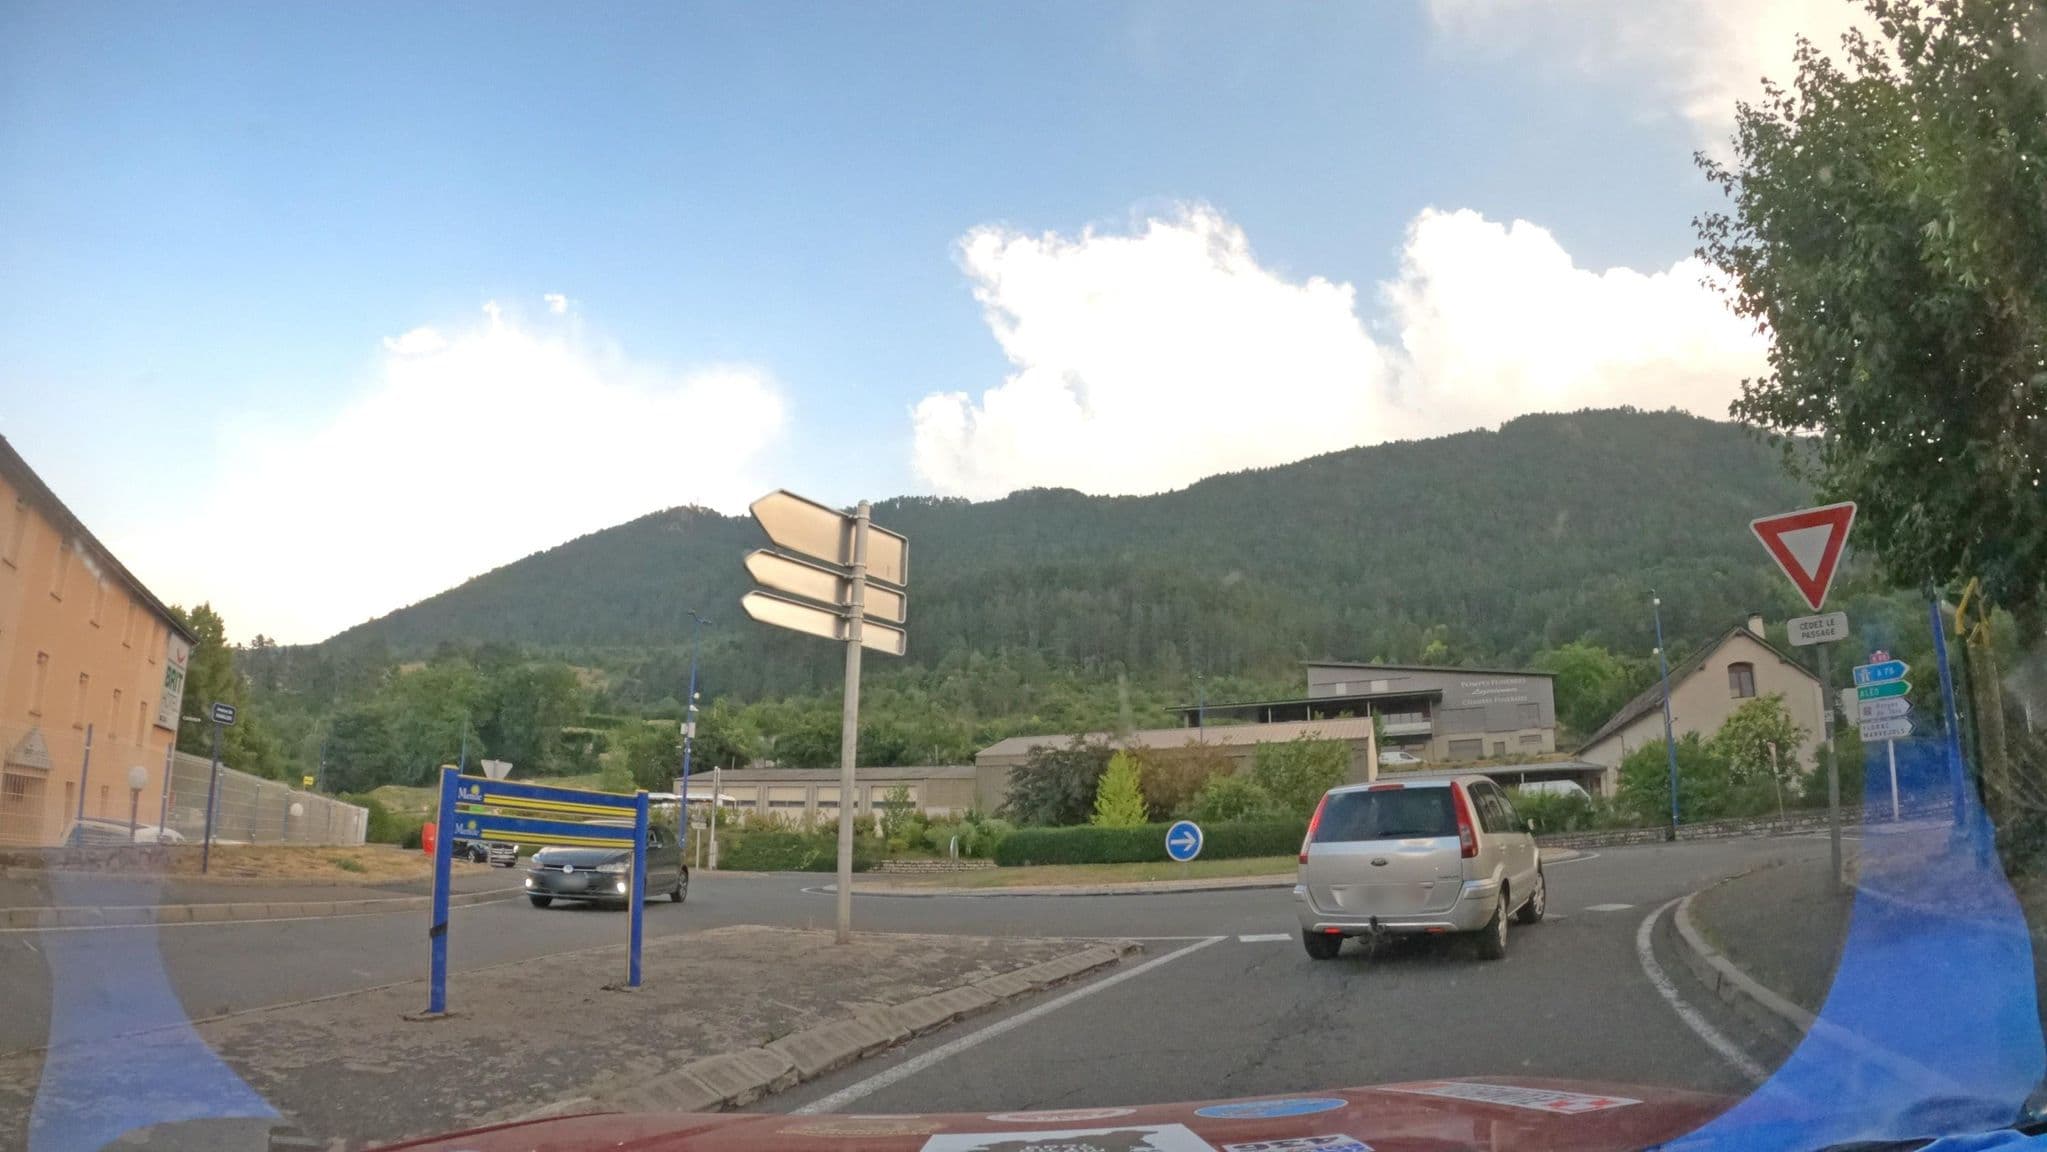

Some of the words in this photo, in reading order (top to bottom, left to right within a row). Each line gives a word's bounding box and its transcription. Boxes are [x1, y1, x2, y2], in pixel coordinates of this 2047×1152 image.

[1826, 618, 1835, 627] LE
[1801, 628, 1836, 639] PASSAGE
[165, 665, 184, 692] BRIT
[1863, 728, 1905, 738] MARVEJOLS
